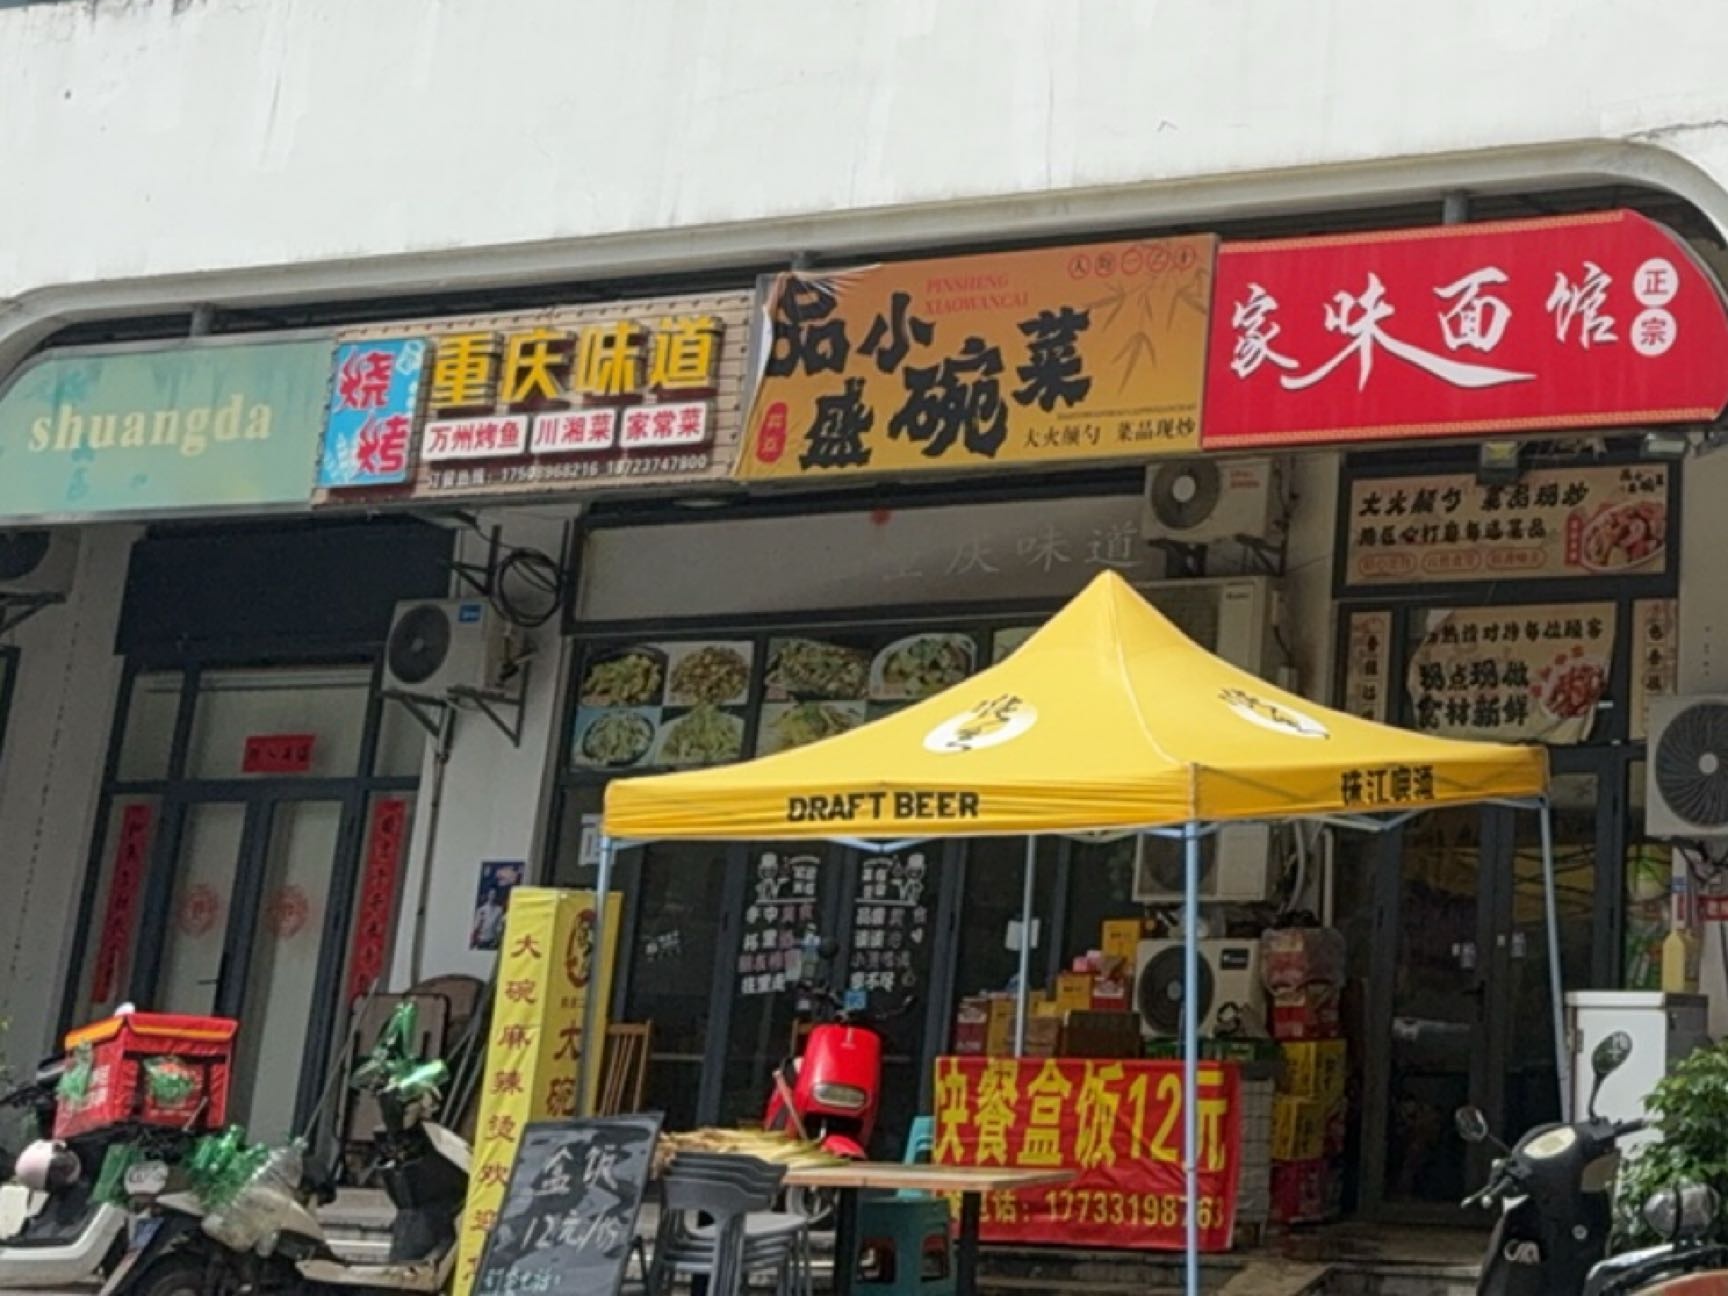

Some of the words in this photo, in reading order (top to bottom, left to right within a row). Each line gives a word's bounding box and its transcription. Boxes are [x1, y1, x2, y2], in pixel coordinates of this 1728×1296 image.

[1229, 260, 1619, 392] 家味面馆
[1637, 266, 1672, 347] 正宗
[430, 315, 724, 408] 重庆味道
[28, 394, 274, 454] shuangda
[338, 348, 410, 475] 烧烤
[534, 415, 613, 447] 川湘菜
[624, 407, 706, 442] 家常菜
[1116, 416, 1196, 442] 菜品现炒
[425, 418, 520, 455] 万州烤鱼
[884, 526, 1144, 580] 庆味道
[1417, 659, 1530, 692] 现点现做
[1416, 694, 1530, 729] 食材新鲜
[787, 793, 886, 824] DRAFT
[895, 789, 980, 820] BEER
[1340, 763, 1436, 806] 珠江啤酒
[935, 1056, 1227, 1172] 快餐盒饭12元
[533, 1144, 620, 1198] 盒饭
